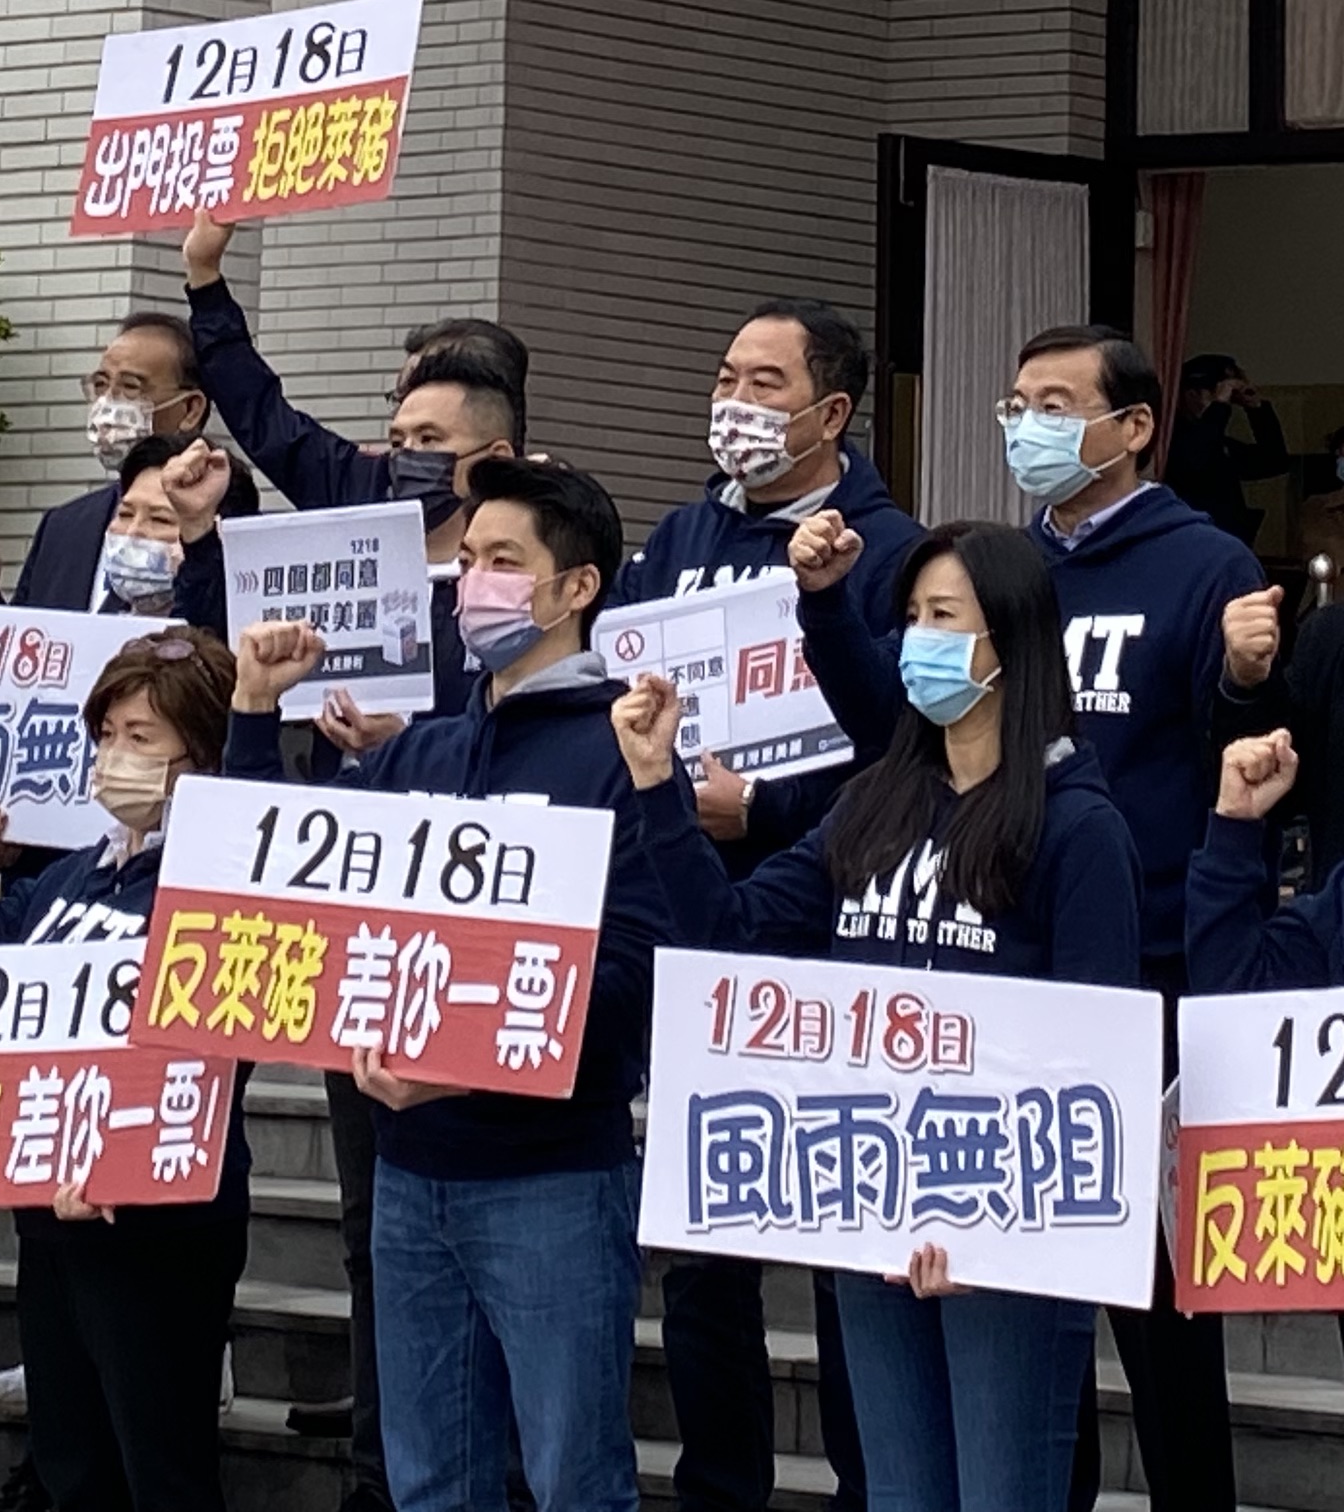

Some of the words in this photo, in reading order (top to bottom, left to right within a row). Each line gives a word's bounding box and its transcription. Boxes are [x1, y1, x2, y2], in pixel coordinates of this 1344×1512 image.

[163, 21, 368, 104] 12月18日
[83, 115, 244, 218] 出門投票
[264, 558, 378, 597] 四個都同意
[250, 805, 536, 906] 12月18日
[148, 909, 329, 1043] 反萊豬
[331, 921, 577, 1071] 差你一票!
[707, 975, 972, 1070] 12月18日
[4, 1060, 220, 1183] 差你一票!
[686, 1083, 1124, 1227] 風雨無阻
